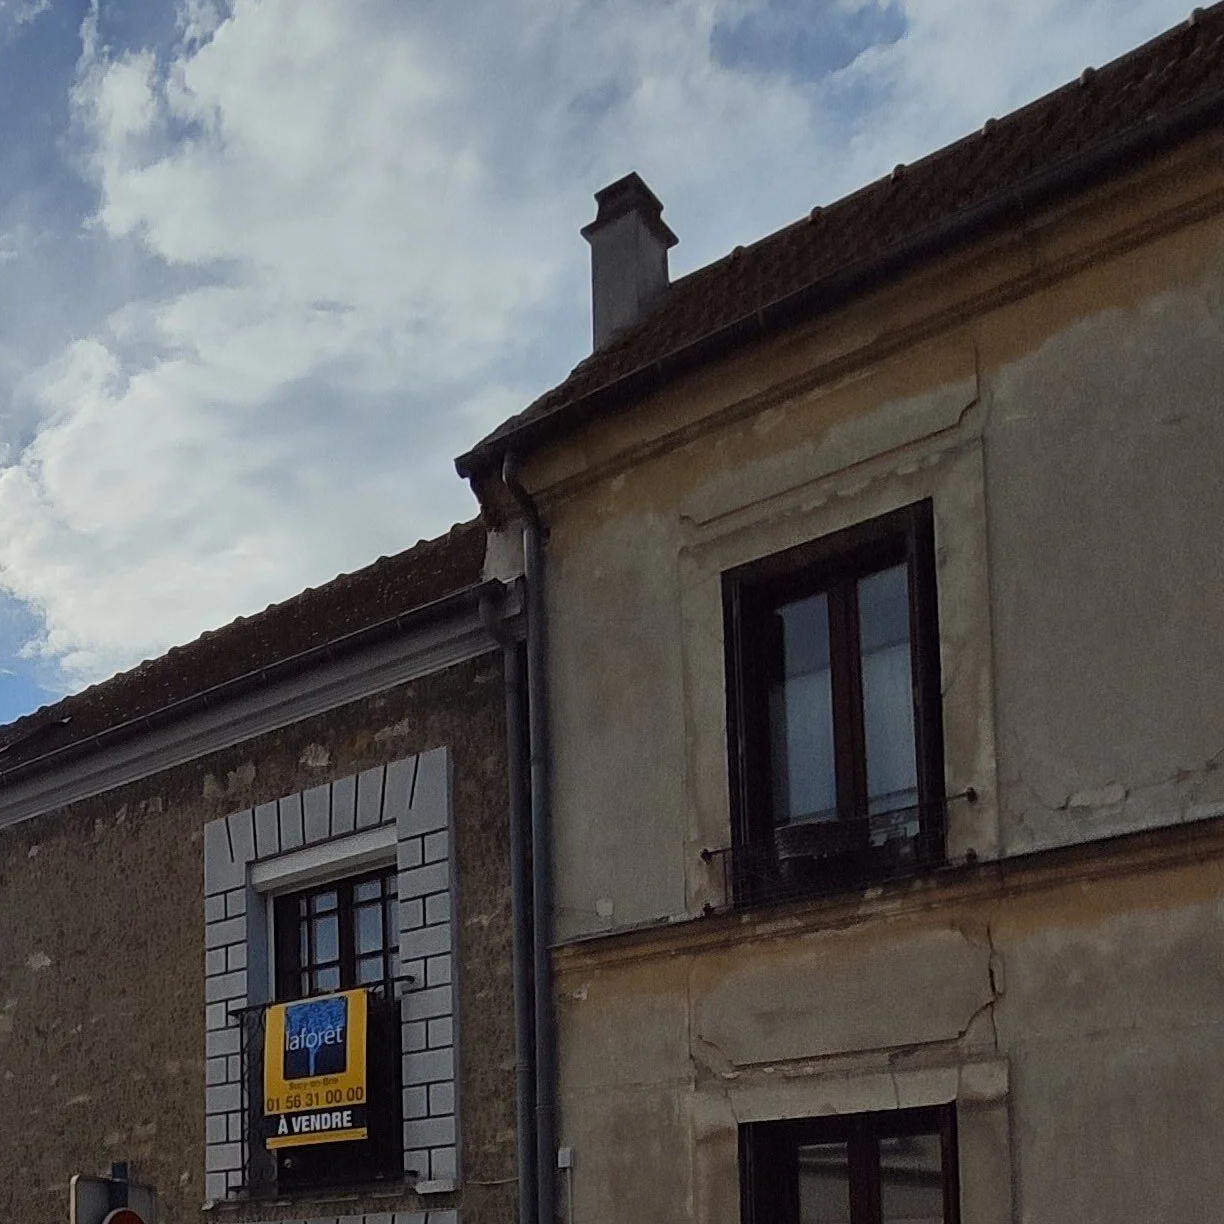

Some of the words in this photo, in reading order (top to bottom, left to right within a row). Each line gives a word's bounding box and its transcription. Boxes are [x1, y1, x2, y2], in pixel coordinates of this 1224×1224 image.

[285, 1023, 343, 1051] laforêt
[267, 1098, 280, 1112] 01
[286, 1095, 302, 1109] 56
[305, 1092, 320, 1106] 31
[326, 1089, 342, 1104] 00
[346, 1086, 364, 1101] 00
[277, 1114, 288, 1135] À
[291, 1110, 353, 1133] VENDRE
